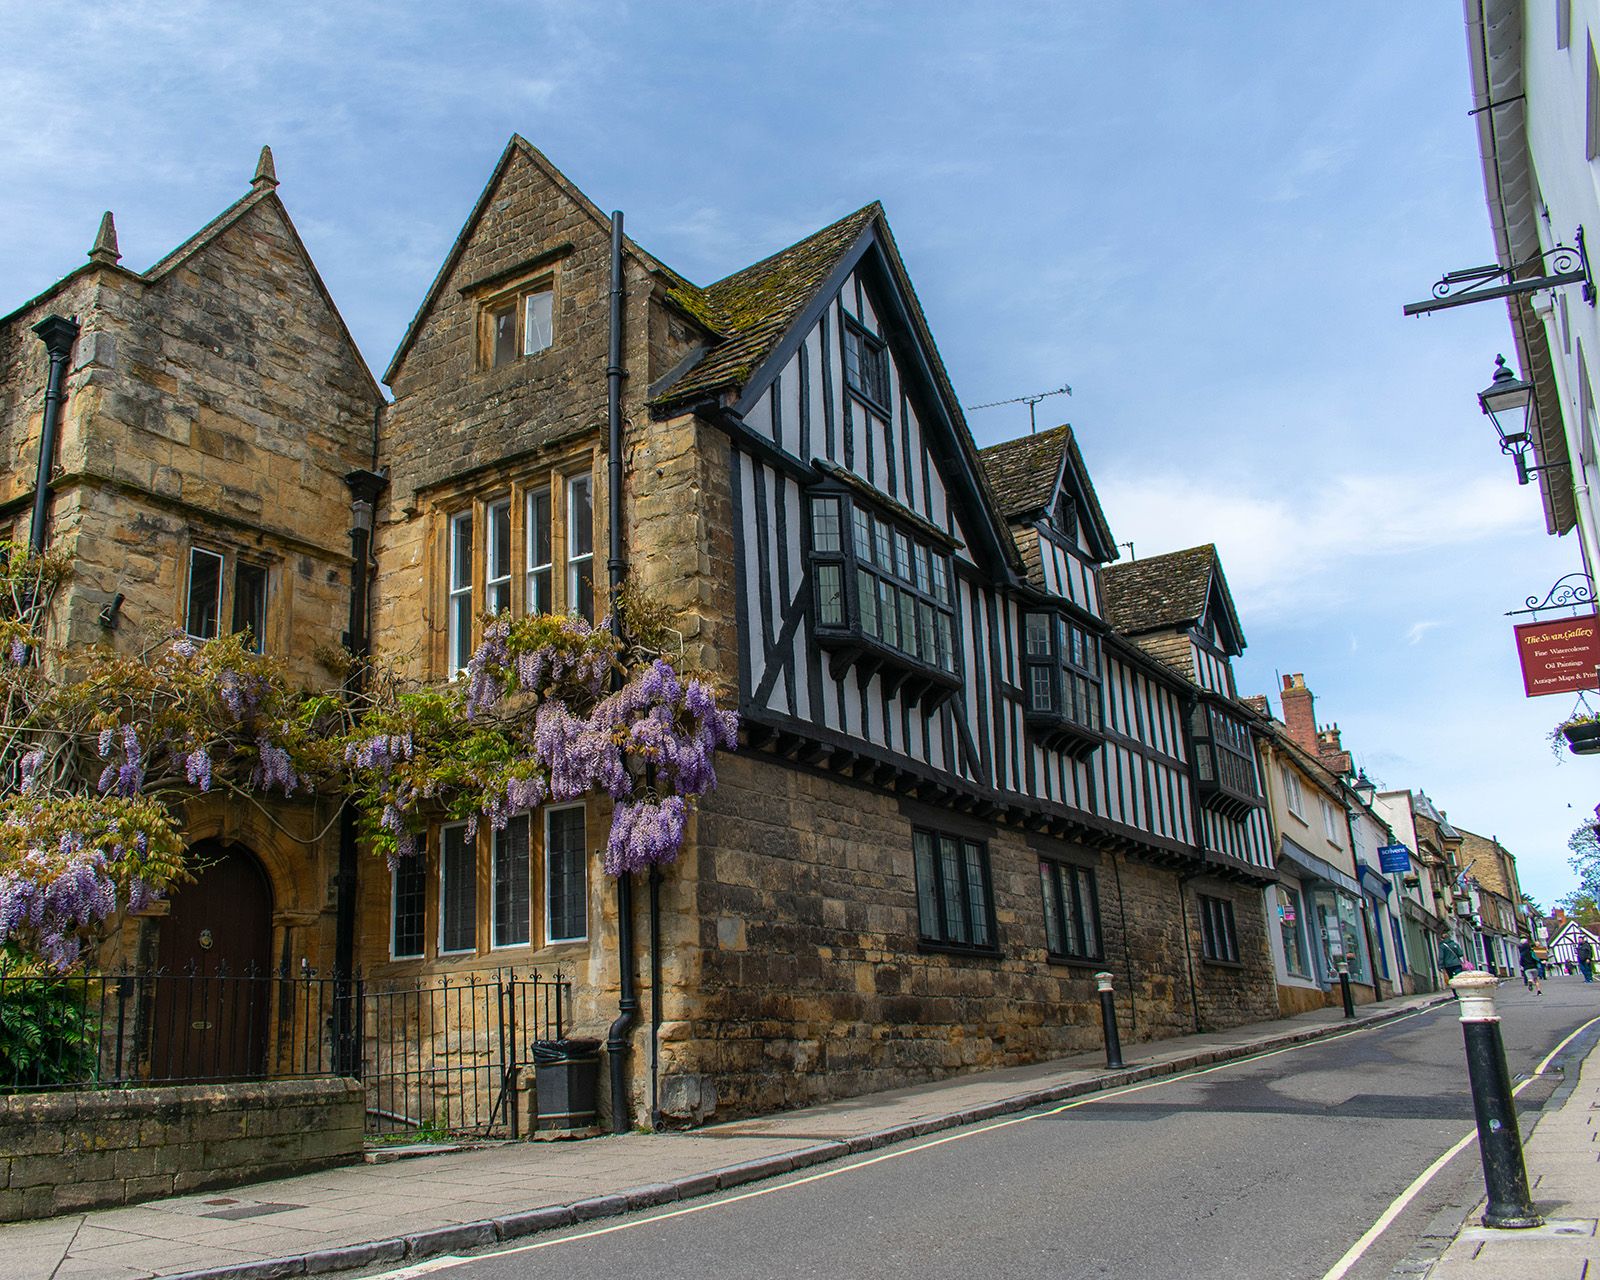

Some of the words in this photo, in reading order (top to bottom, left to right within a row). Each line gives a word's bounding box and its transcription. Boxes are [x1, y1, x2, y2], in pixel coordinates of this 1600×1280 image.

[1524, 636, 1540, 644] The
[1541, 634, 1564, 642] Swan
[1564, 628, 1593, 640] Gallery
[1550, 646, 1590, 654] Watercolours
